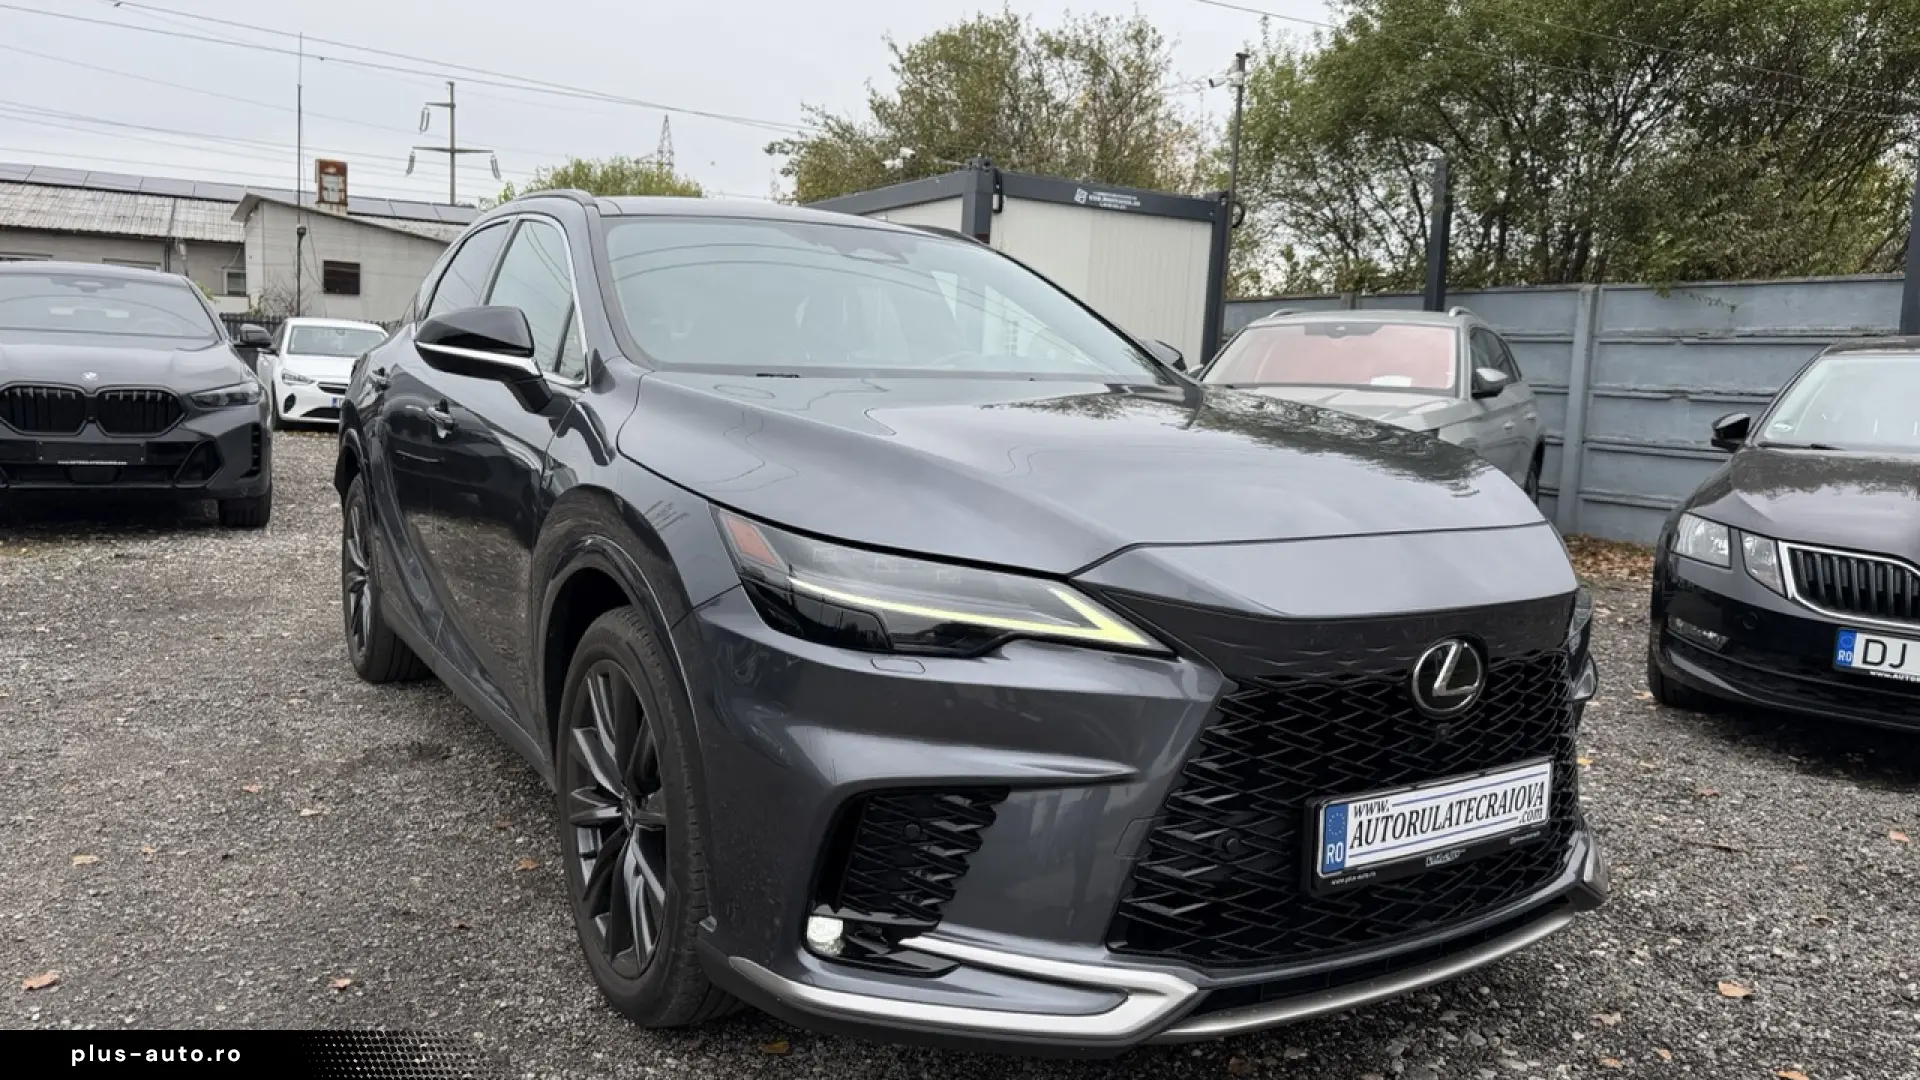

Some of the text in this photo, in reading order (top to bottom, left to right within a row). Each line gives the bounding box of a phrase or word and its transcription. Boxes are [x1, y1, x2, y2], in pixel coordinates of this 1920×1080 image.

[1838, 650, 1852, 662] RO
[1862, 638, 1907, 669] DJ
[1349, 781, 1545, 849] AUTORULATECRAIOVA
[1353, 799, 1389, 818] www.
[1326, 841, 1344, 864] RO
